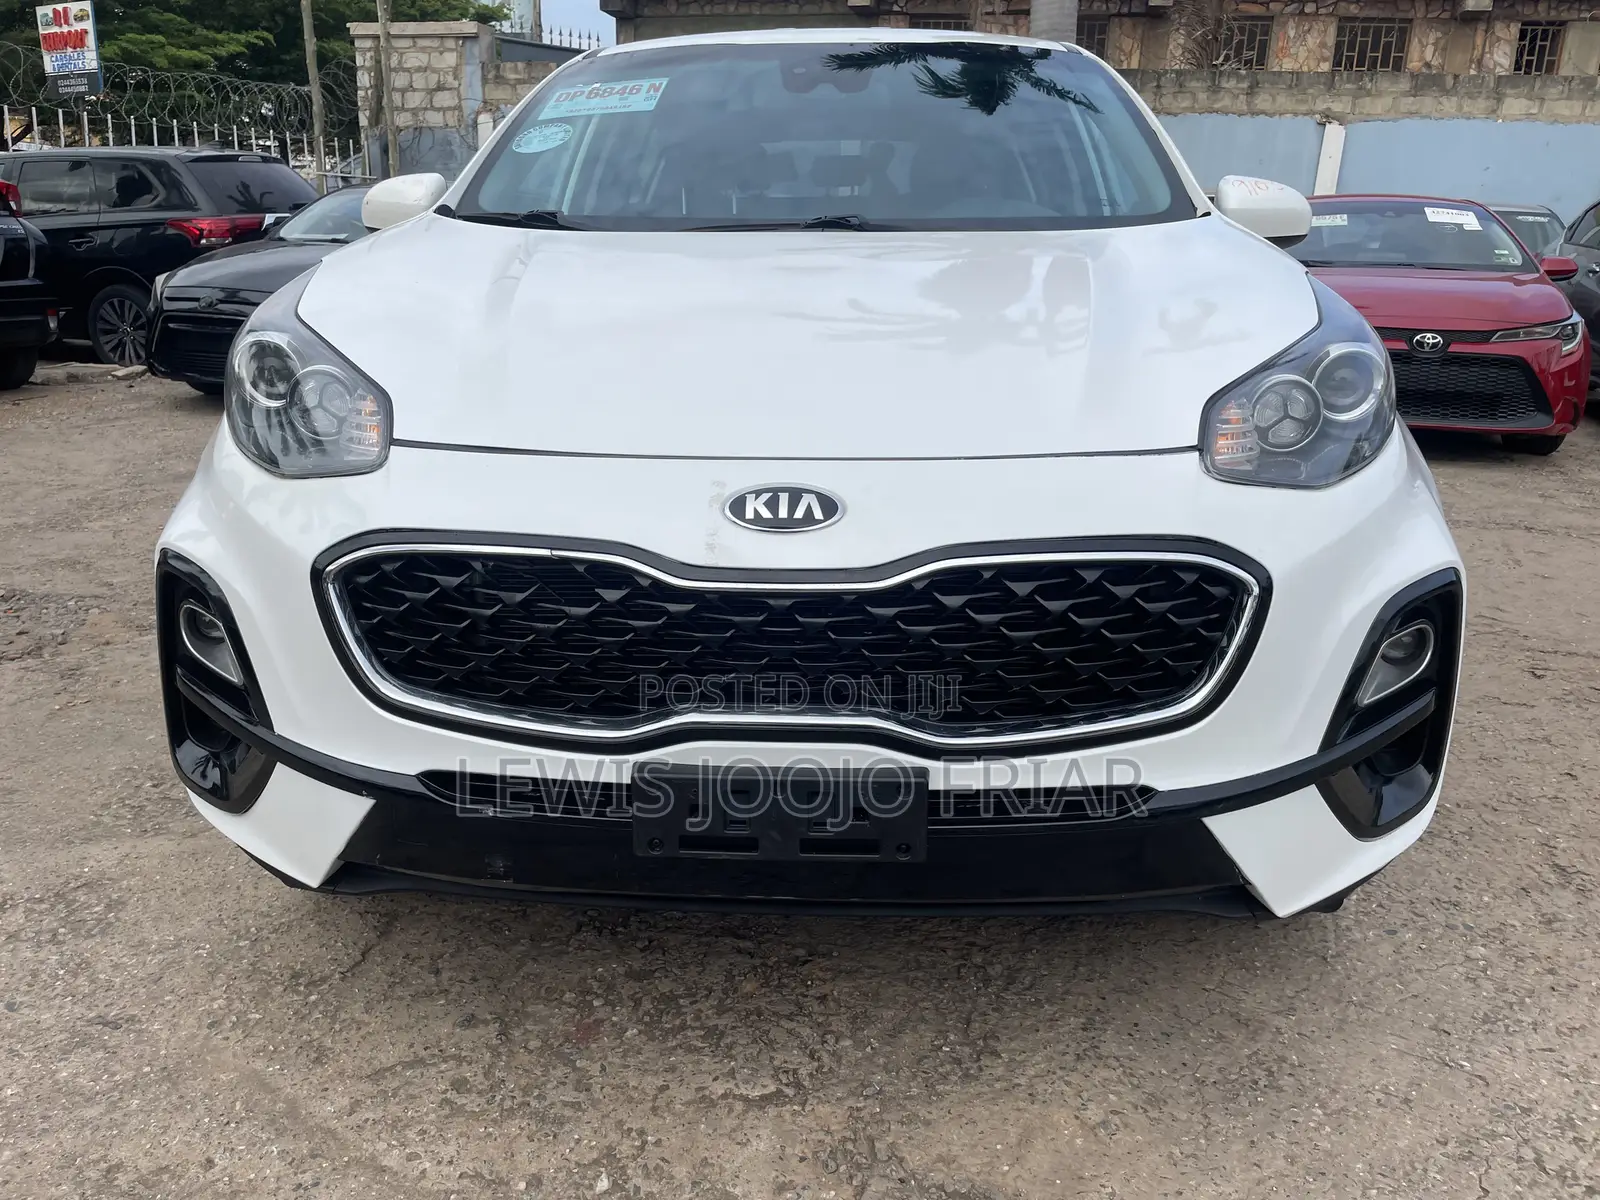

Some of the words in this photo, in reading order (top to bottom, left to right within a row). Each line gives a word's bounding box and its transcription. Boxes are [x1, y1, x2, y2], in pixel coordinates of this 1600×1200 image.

[554, 90, 586, 103] DP
[585, 83, 644, 101] 6846
[645, 81, 664, 95] N
[744, 491, 825, 521] KIA
